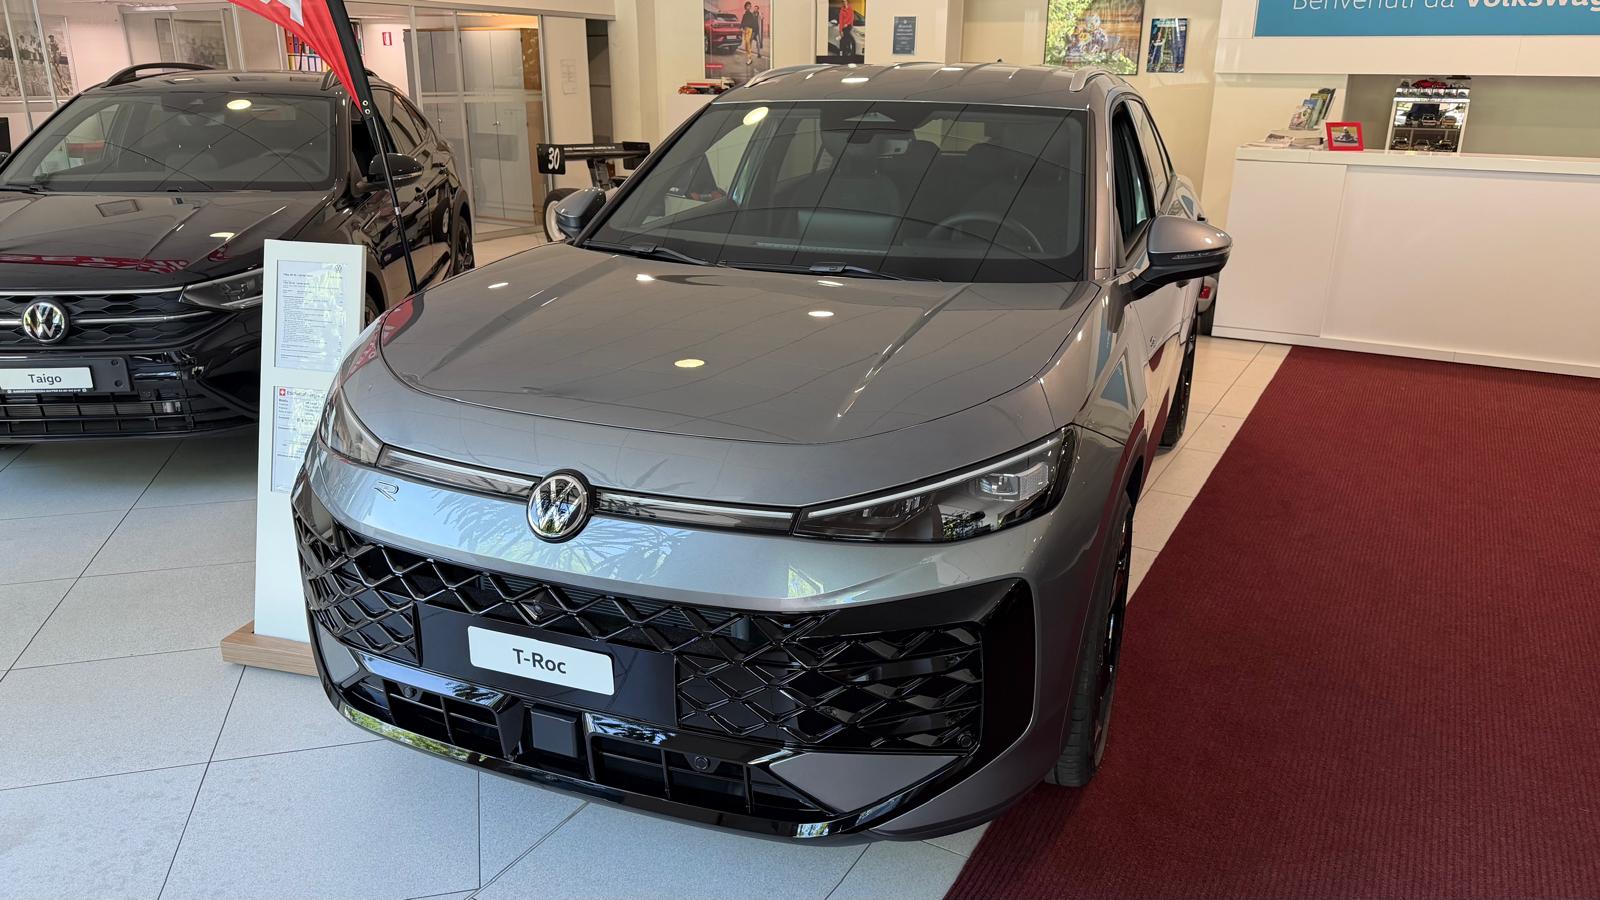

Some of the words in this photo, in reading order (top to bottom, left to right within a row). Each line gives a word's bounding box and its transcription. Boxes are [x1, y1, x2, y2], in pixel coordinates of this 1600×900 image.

[547, 147, 561, 170] 30
[27, 373, 62, 386] Taigo
[512, 647, 567, 675] T-Roc
